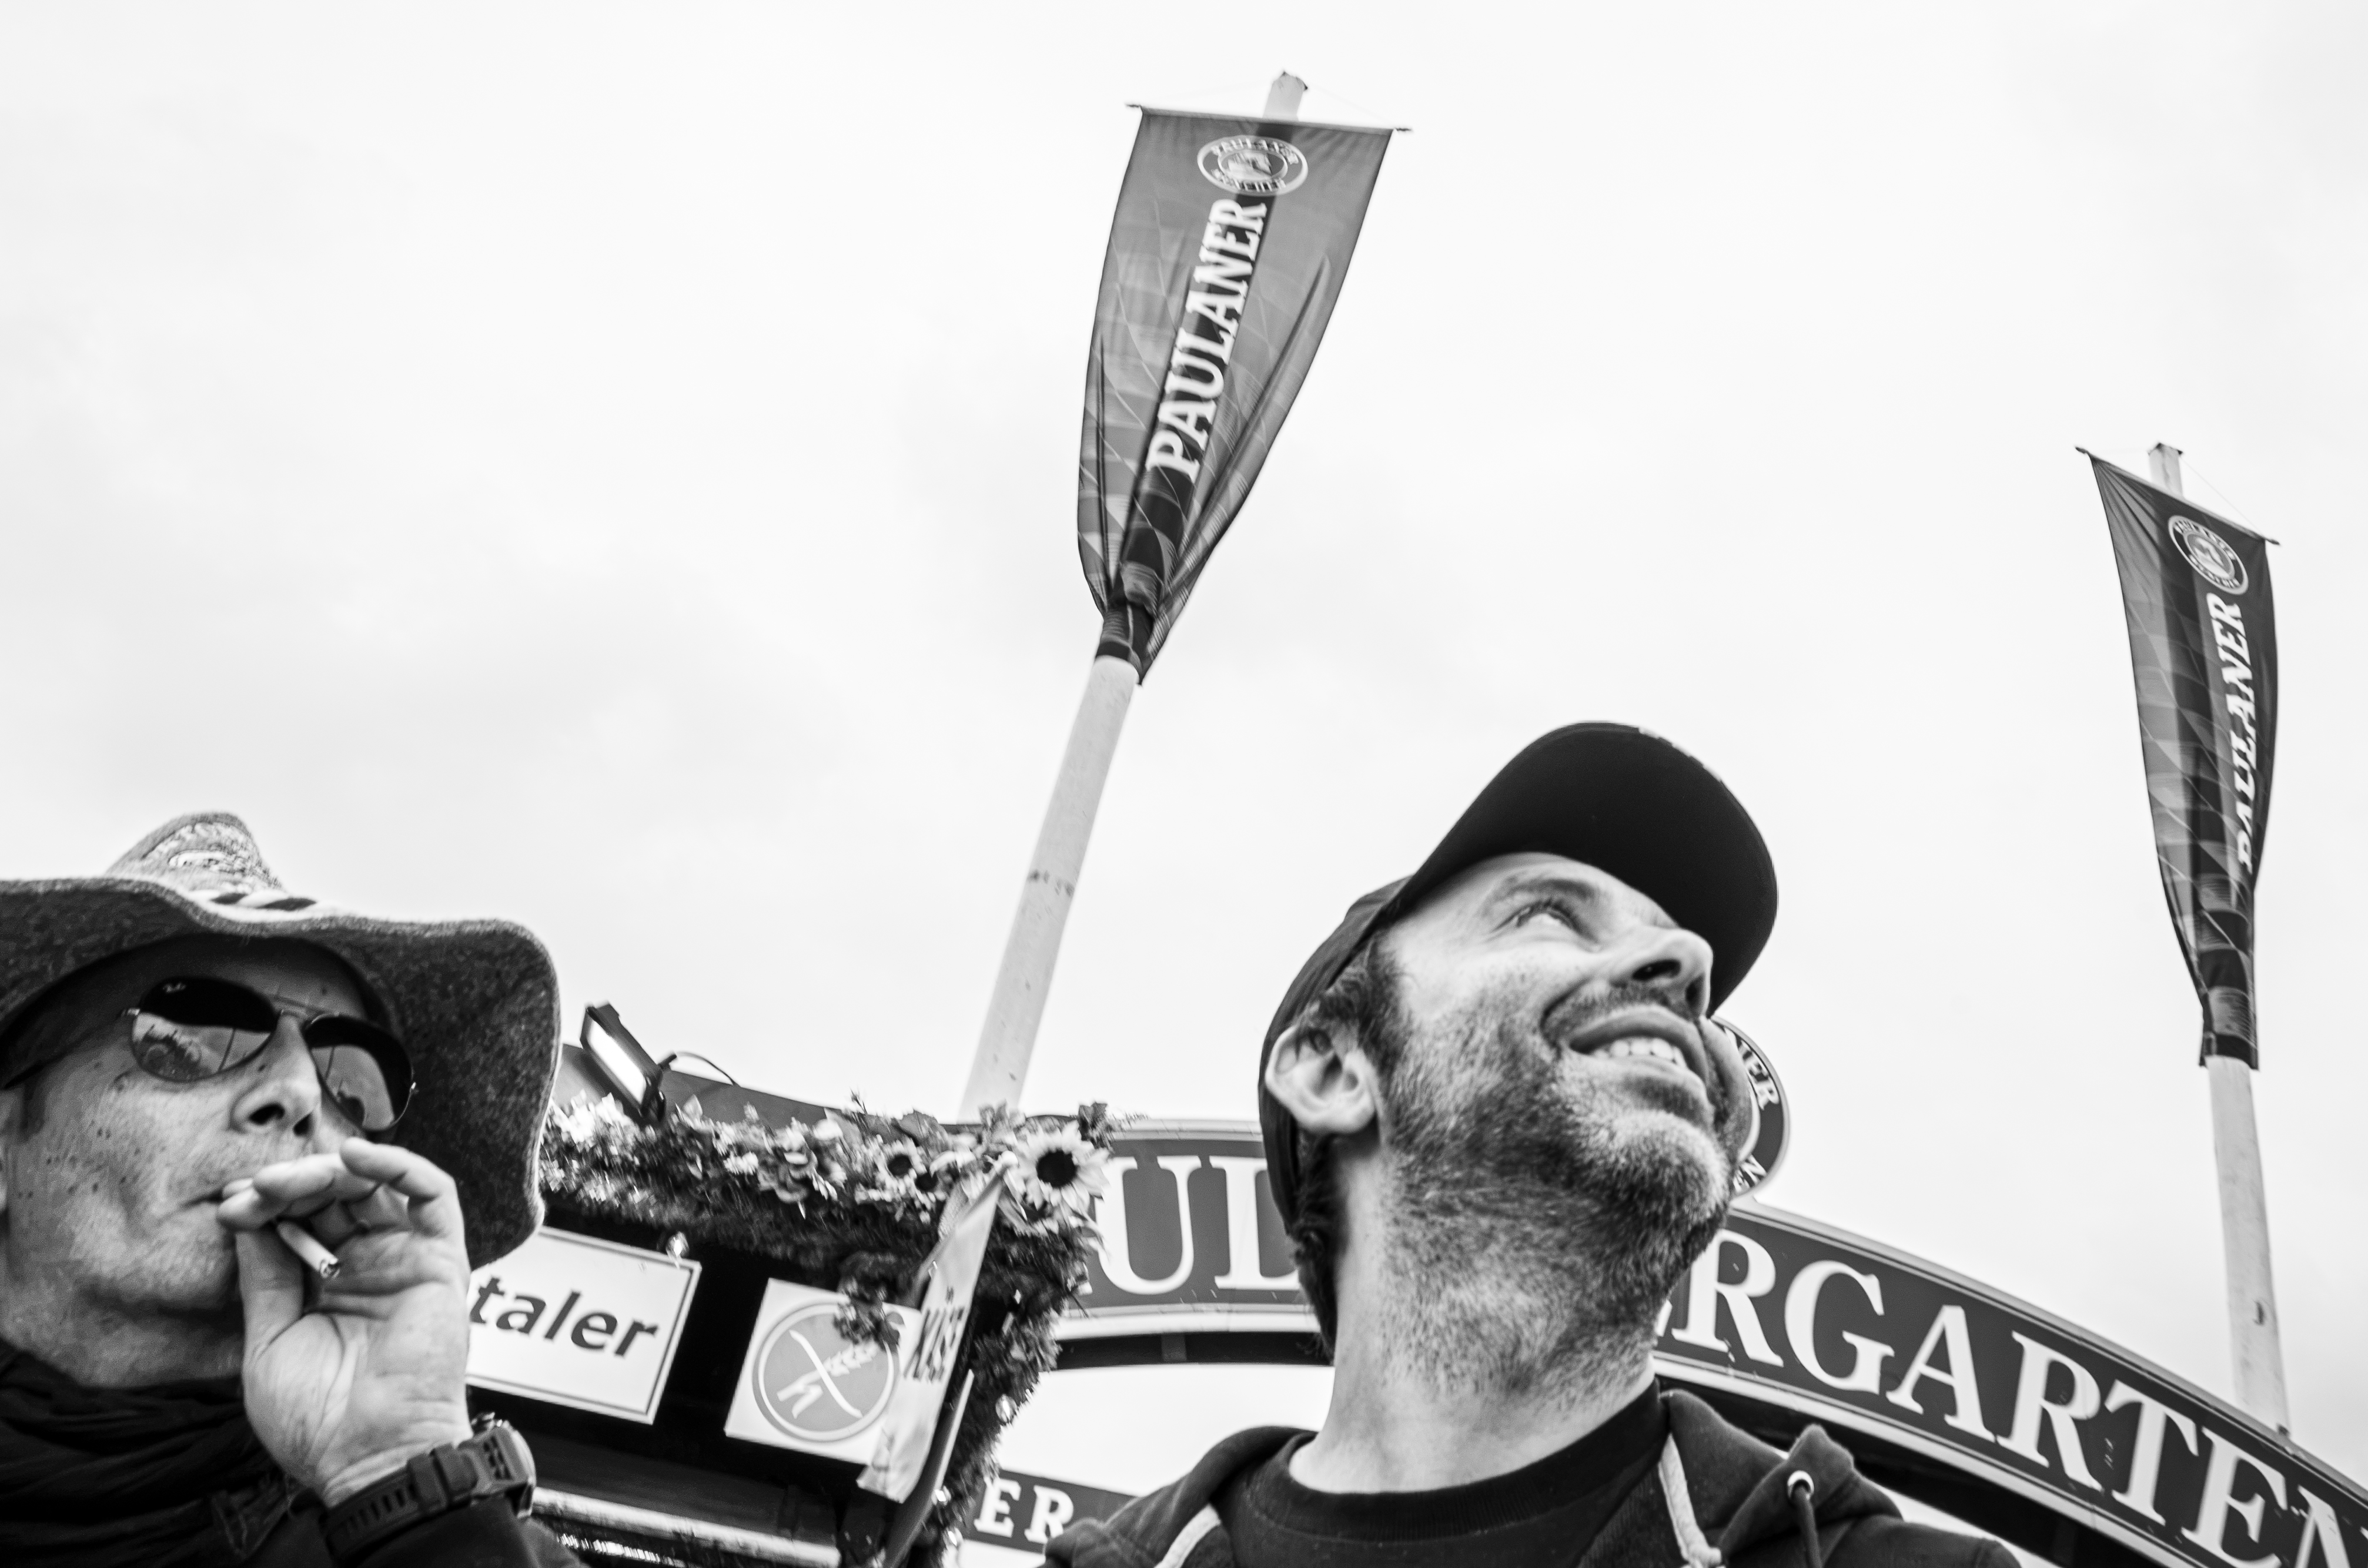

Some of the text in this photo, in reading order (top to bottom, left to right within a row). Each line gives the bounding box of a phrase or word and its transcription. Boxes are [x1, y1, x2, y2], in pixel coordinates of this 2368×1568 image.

[1145, 199, 1267, 483] PAULANER
[470, 1276, 659, 1358] taler
[1654, 1229, 2368, 1568] RGARTE
